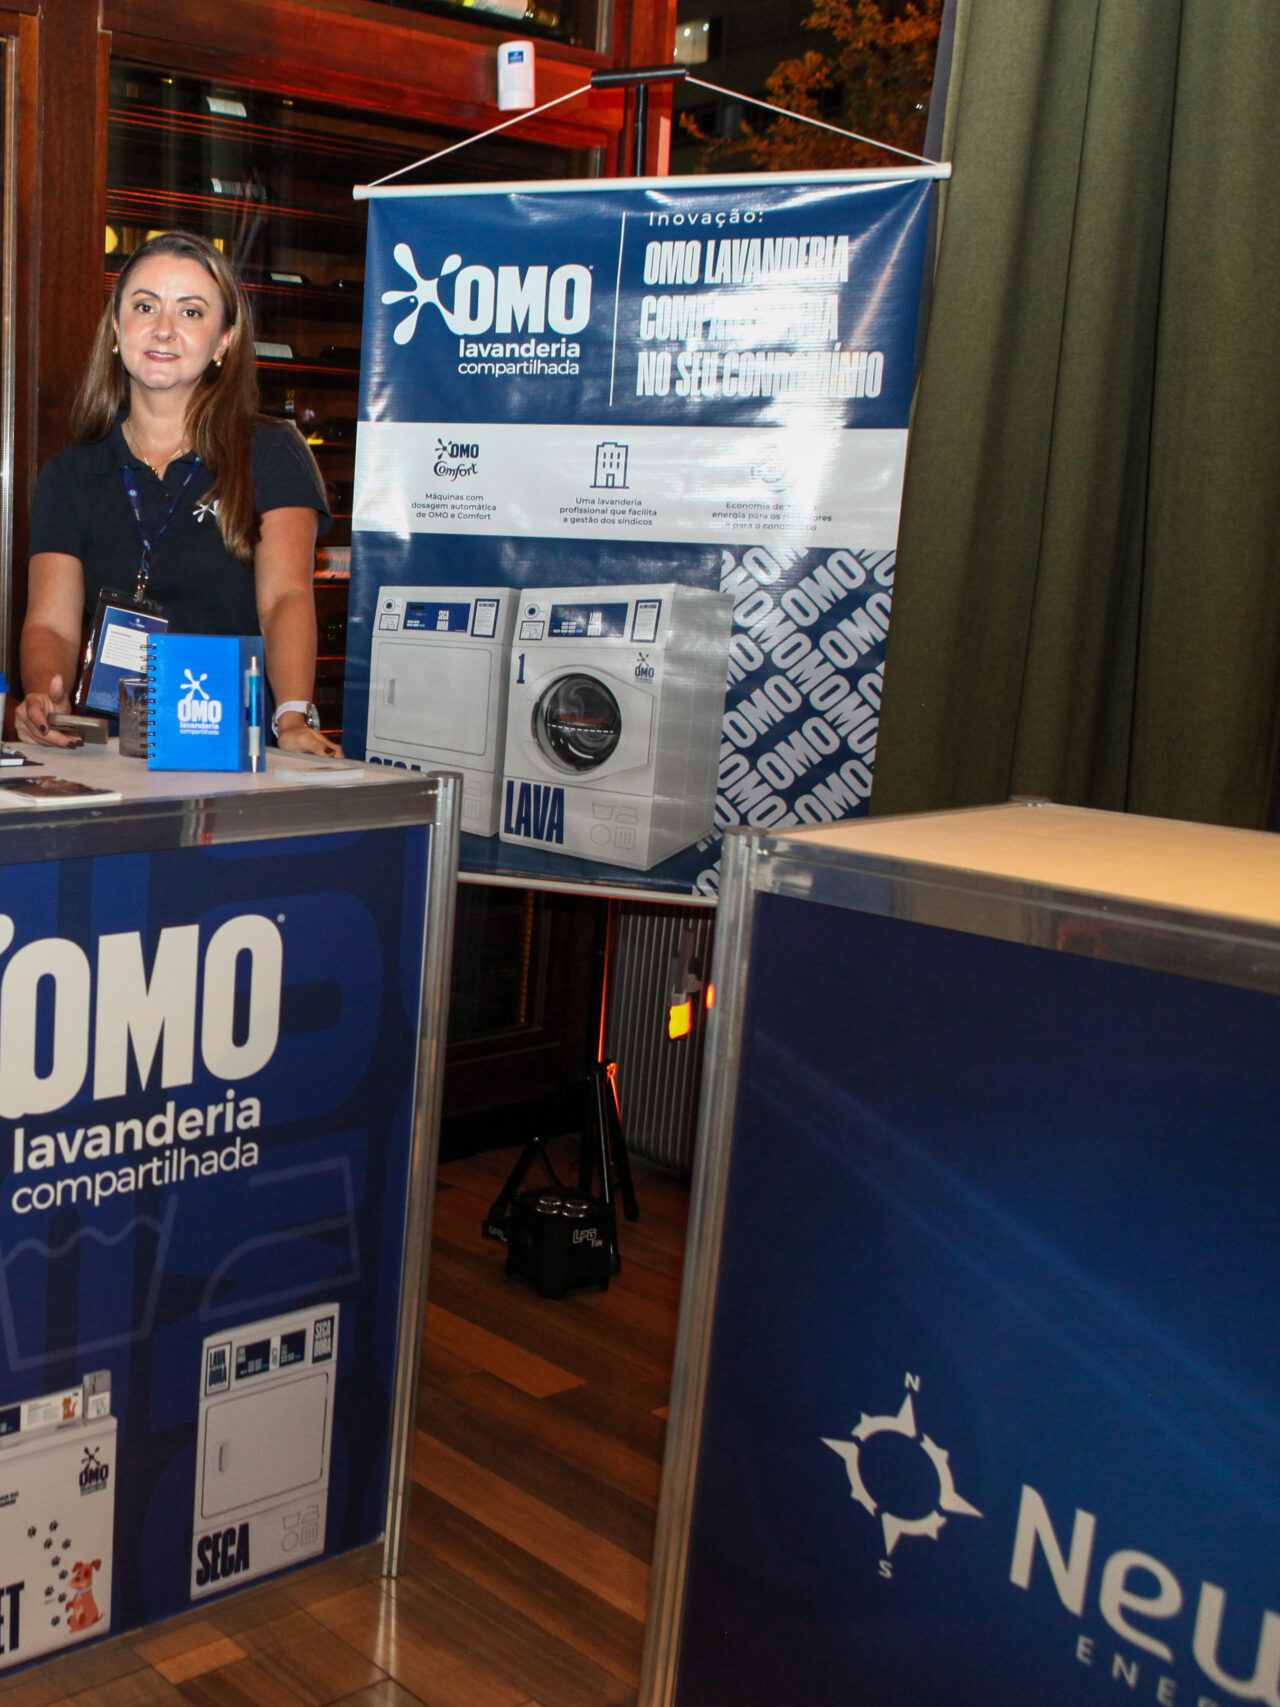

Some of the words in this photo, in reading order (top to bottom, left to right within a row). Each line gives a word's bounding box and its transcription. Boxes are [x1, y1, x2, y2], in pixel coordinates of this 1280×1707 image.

[649, 208, 764, 228] Inovação:
[643, 239, 702, 285] OMO
[704, 235, 849, 285] LAVANDERIA
[454, 264, 592, 335] OMO
[459, 338, 580, 358] lavanderia
[458, 360, 580, 378] compartilhada
[636, 351, 672, 397] NO
[675, 351, 720, 397] SEU
[721, 342, 885, 398] CONDOÍNIO
[449, 443, 480, 459] OMO
[433, 460, 478, 481] Comfort
[411, 502, 448, 511] dosagem
[450, 503, 497, 511] automática
[425, 493, 464, 502] Máquinas
[575, 497, 596, 505] Uma
[597, 497, 642, 506] lavanderia
[772, 502, 784, 510] de
[428, 511, 449, 519] OMO
[457, 512, 491, 520] Comfort
[560, 506, 608, 515] profissional
[610, 508, 626, 516] que
[628, 508, 657, 516] facilita
[570, 516, 599, 524] gestão
[617, 517, 653, 526] síndicos
[712, 510, 746, 520] energia
[748, 513, 768, 521] para
[780, 550, 866, 627] OMO
[516, 653, 526, 684] 1
[634, 666, 655, 678] OMO
[177, 699, 223, 723] OMO
[722, 674, 802, 749] OMO
[179, 721, 220, 730] lavanderia
[757, 717, 840, 790] OMO
[504, 780, 565, 844] LAVA
[0, 914, 284, 1116] OMO
[12, 1089, 261, 1174] lavanderia
[11, 1138, 259, 1215] compartilhada
[904, 1371, 920, 1393] N
[79, 1464, 109, 1486] OMO
[196, 1522, 250, 1586] SECA
[878, 1559, 893, 1580] S
[1009, 1483, 1280, 1701] Neu
